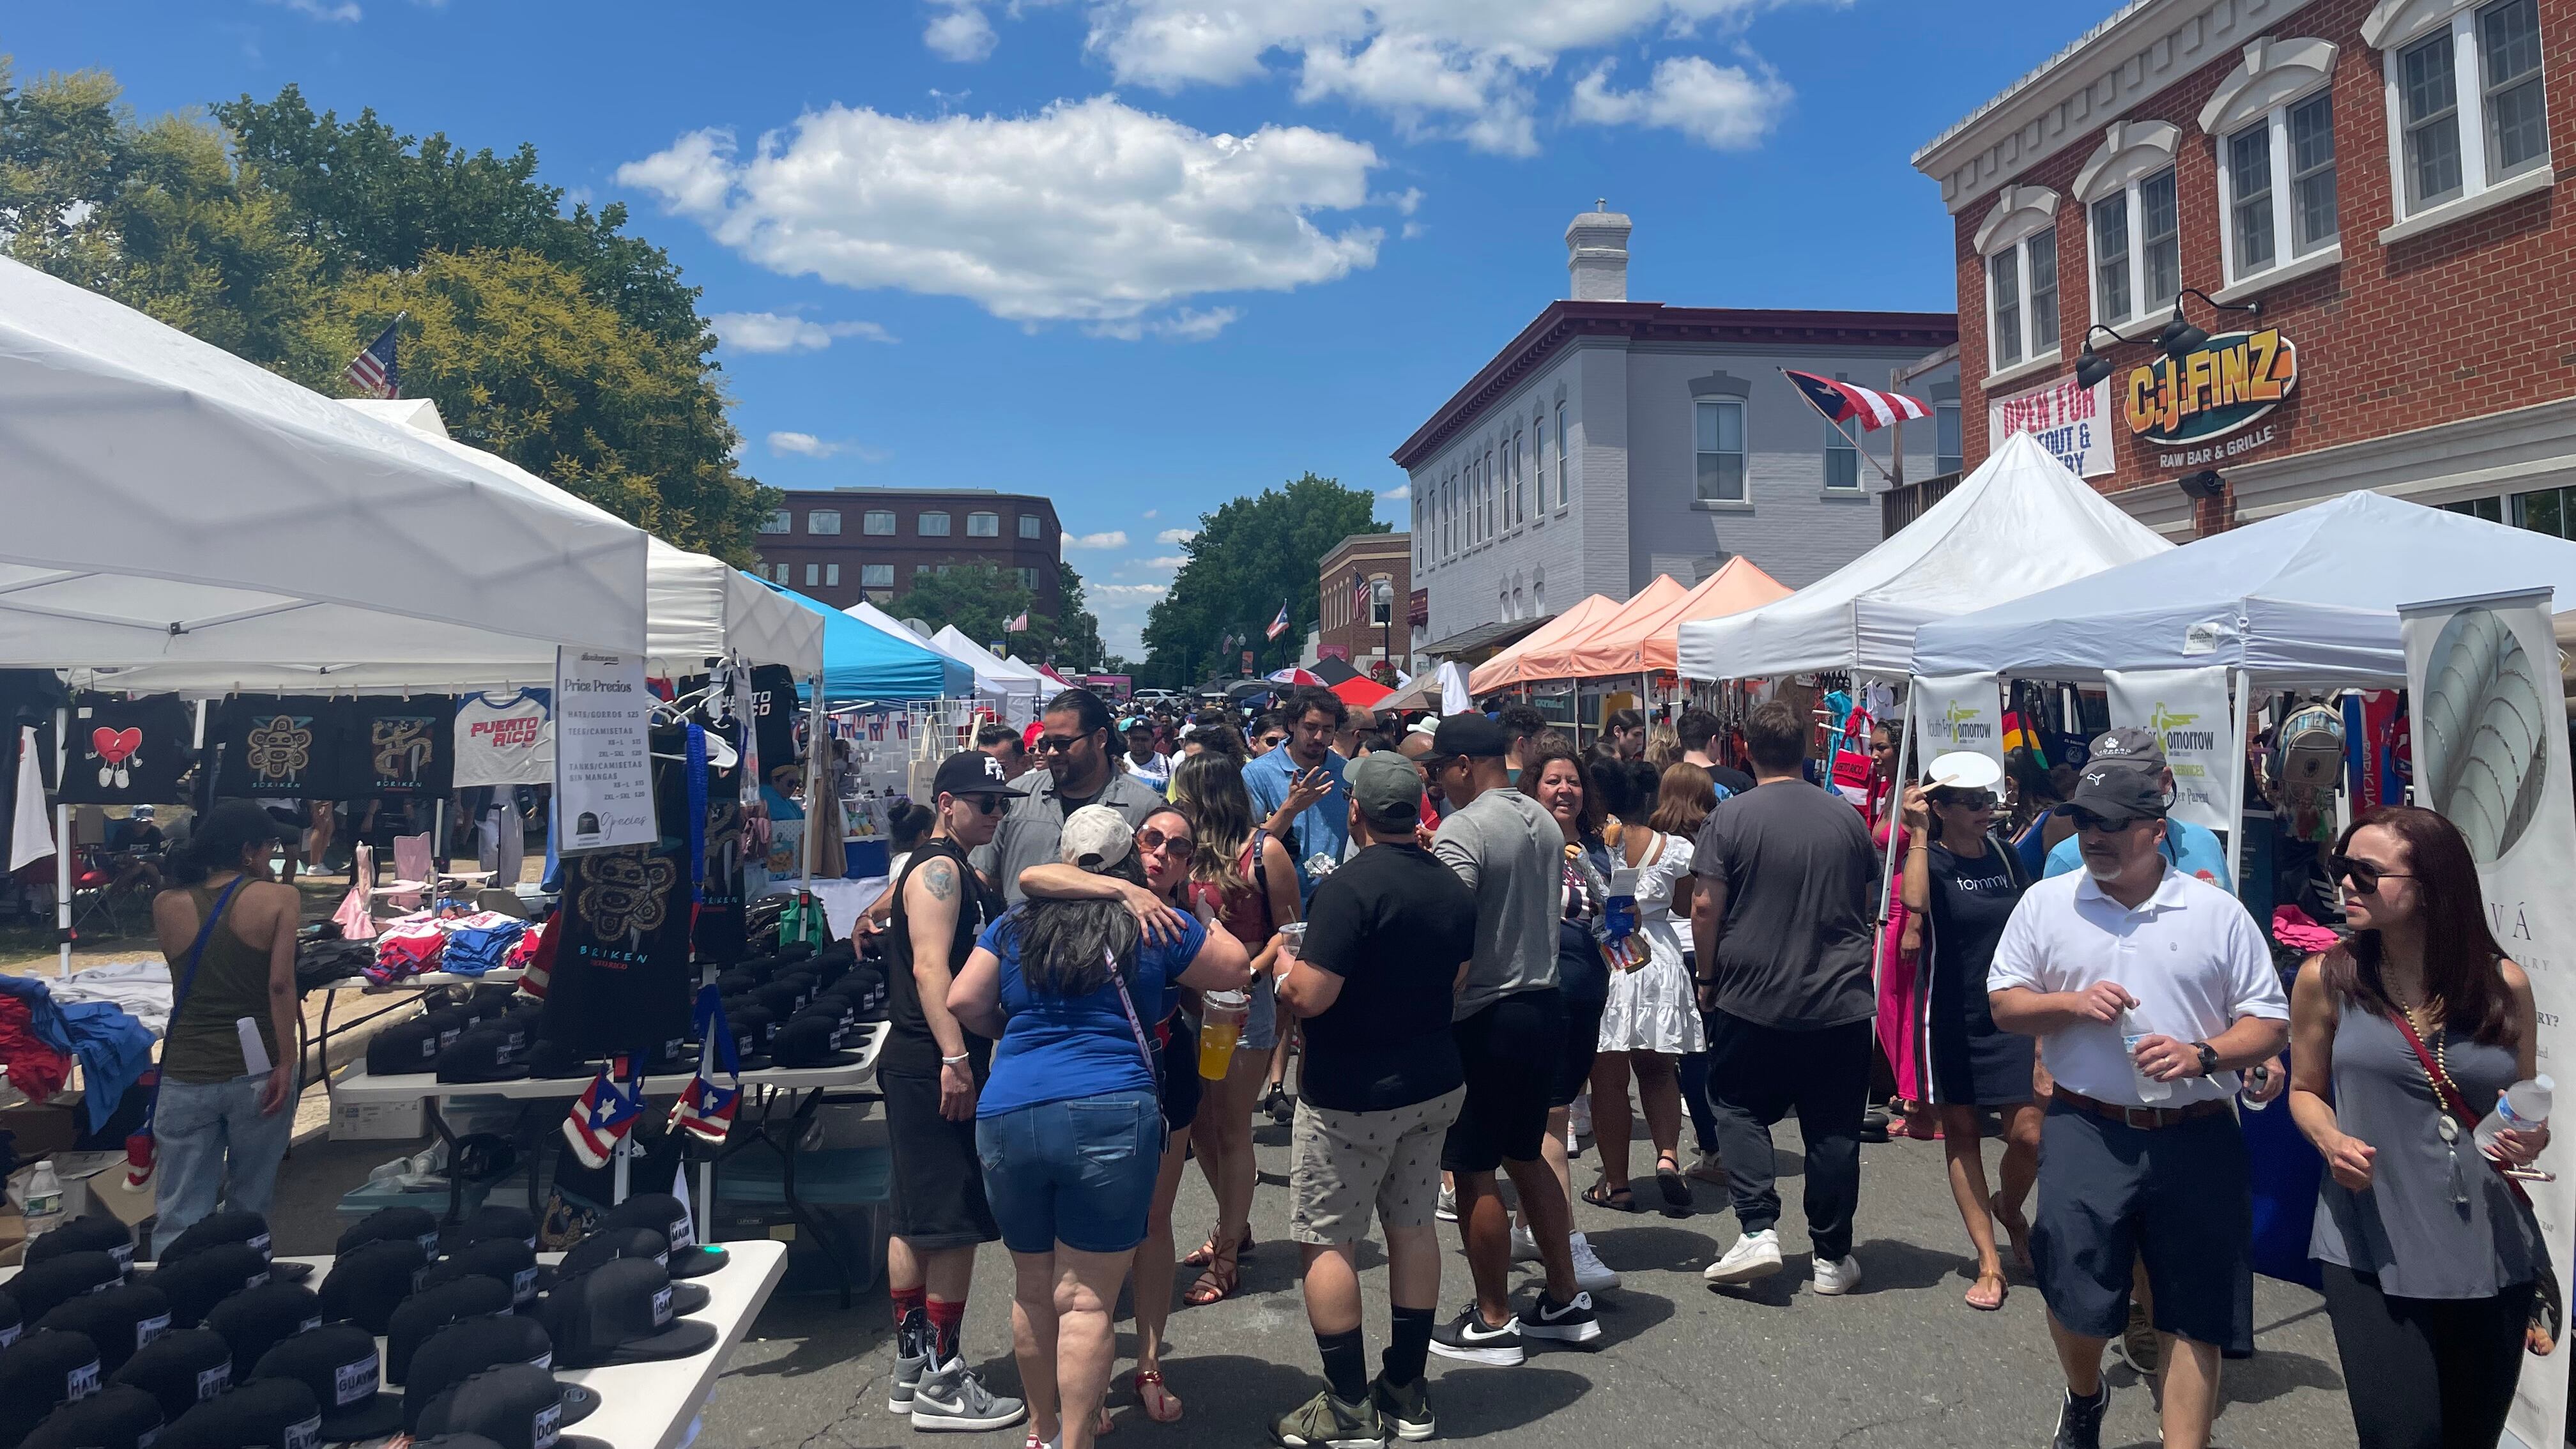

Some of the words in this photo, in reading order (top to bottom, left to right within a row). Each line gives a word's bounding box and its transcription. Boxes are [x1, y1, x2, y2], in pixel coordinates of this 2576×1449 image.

[2004, 389, 2050, 440] OPEN
[2080, 423, 2091, 449] &
[2160, 454, 2184, 468] RAW
[2187, 448, 2211, 465] BAR
[2214, 445, 2225, 459] &
[2227, 425, 2274, 456] GRILLE
[564, 678, 591, 692] Price
[593, 679, 632, 693] Precios
[470, 716, 539, 737] PUERTO
[1926, 718, 1942, 737] Youth
[1942, 718, 1952, 737] For
[493, 730, 537, 747] RICO
[585, 772, 618, 781] MANGAS
[2174, 764, 2204, 777] SERVICES
[1956, 874, 2008, 891] tommy
